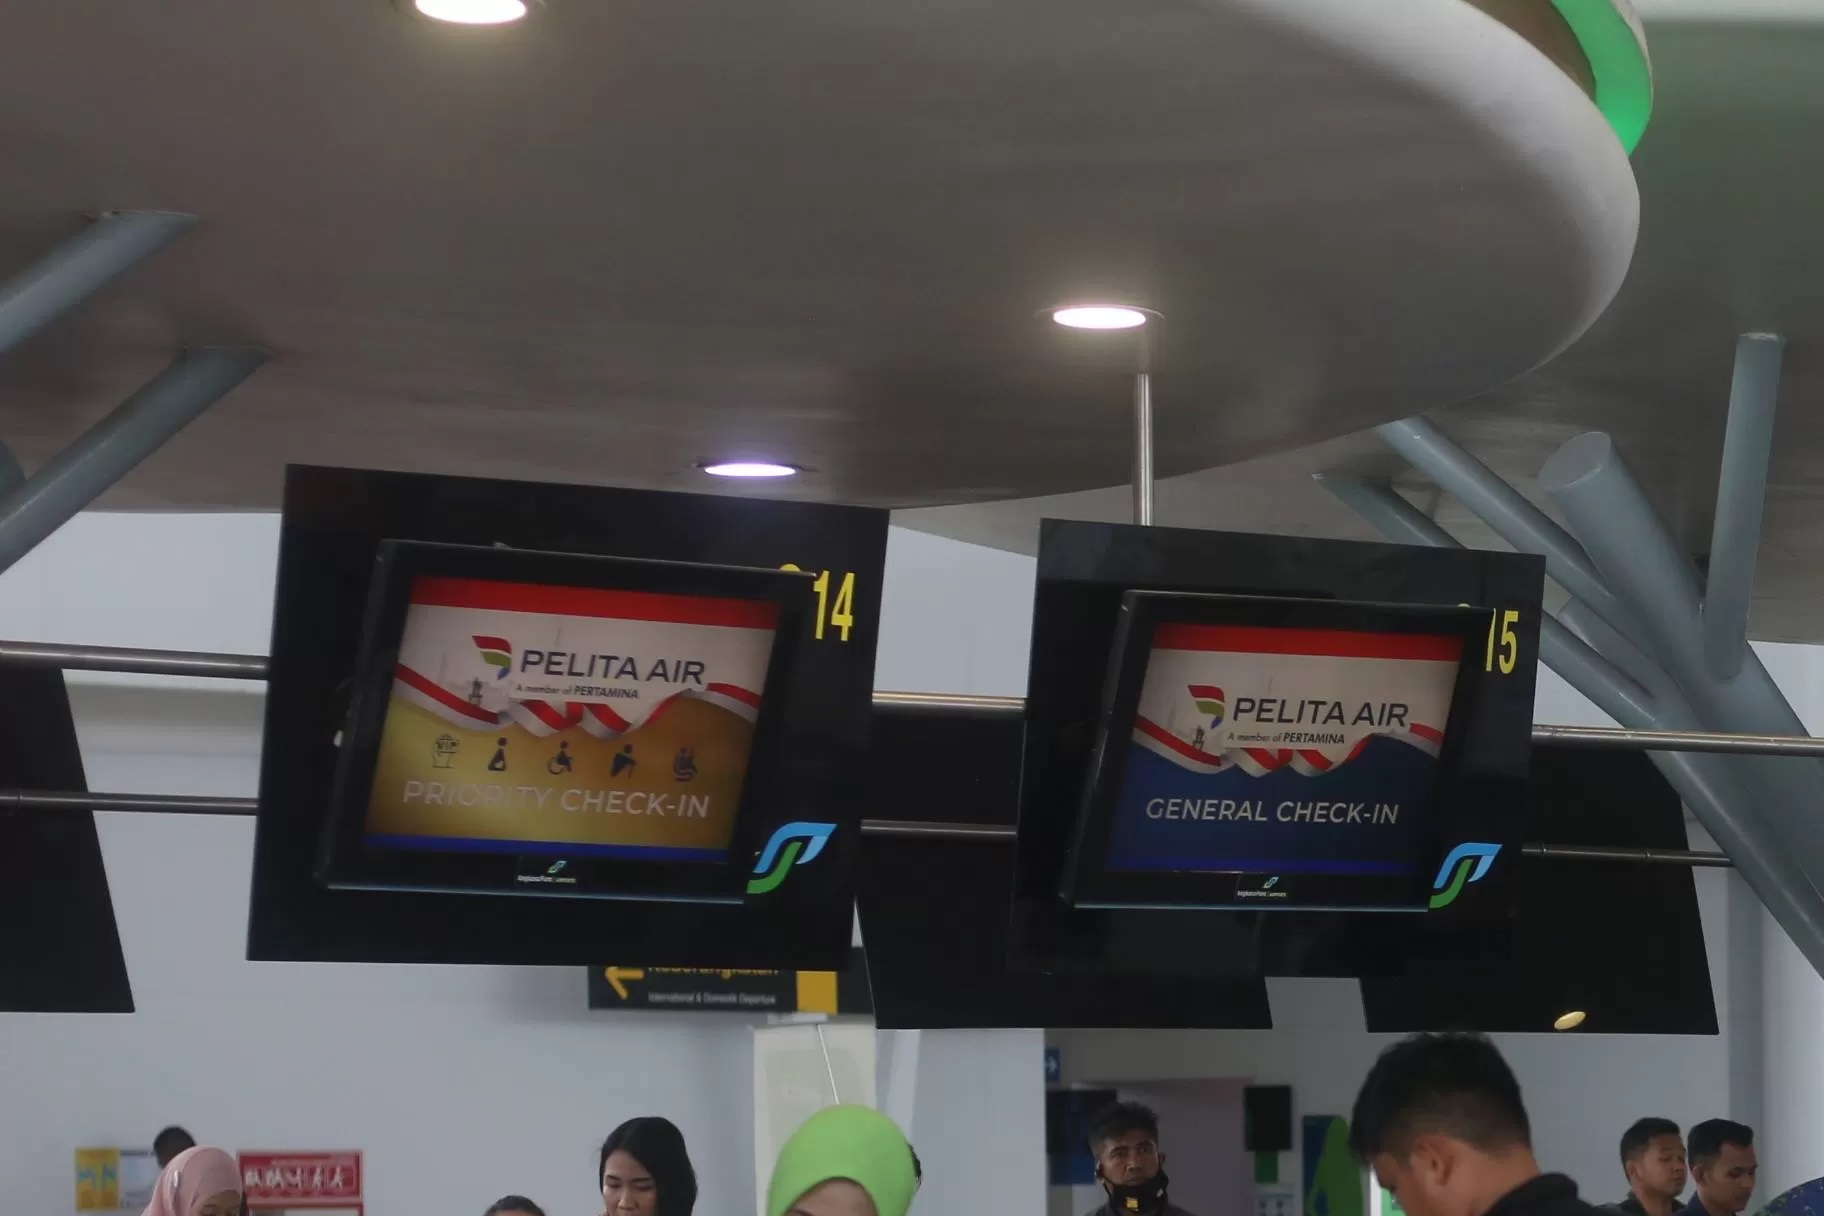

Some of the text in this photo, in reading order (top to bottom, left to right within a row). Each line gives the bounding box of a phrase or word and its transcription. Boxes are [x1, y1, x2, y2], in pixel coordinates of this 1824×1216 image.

[779, 563, 855, 641] 14
[520, 649, 706, 686] PELITA AIR
[573, 685, 640, 699] PERTAMINA
[1232, 697, 1410, 728] PELITA AIR
[1236, 733, 1271, 743] member
[1272, 733, 1282, 743] of
[1283, 732, 1345, 745] PERTAMINA
[402, 779, 711, 819] PRIORITY CHECK-IN
[1145, 798, 1399, 825] GENERAL CHECK-IN
